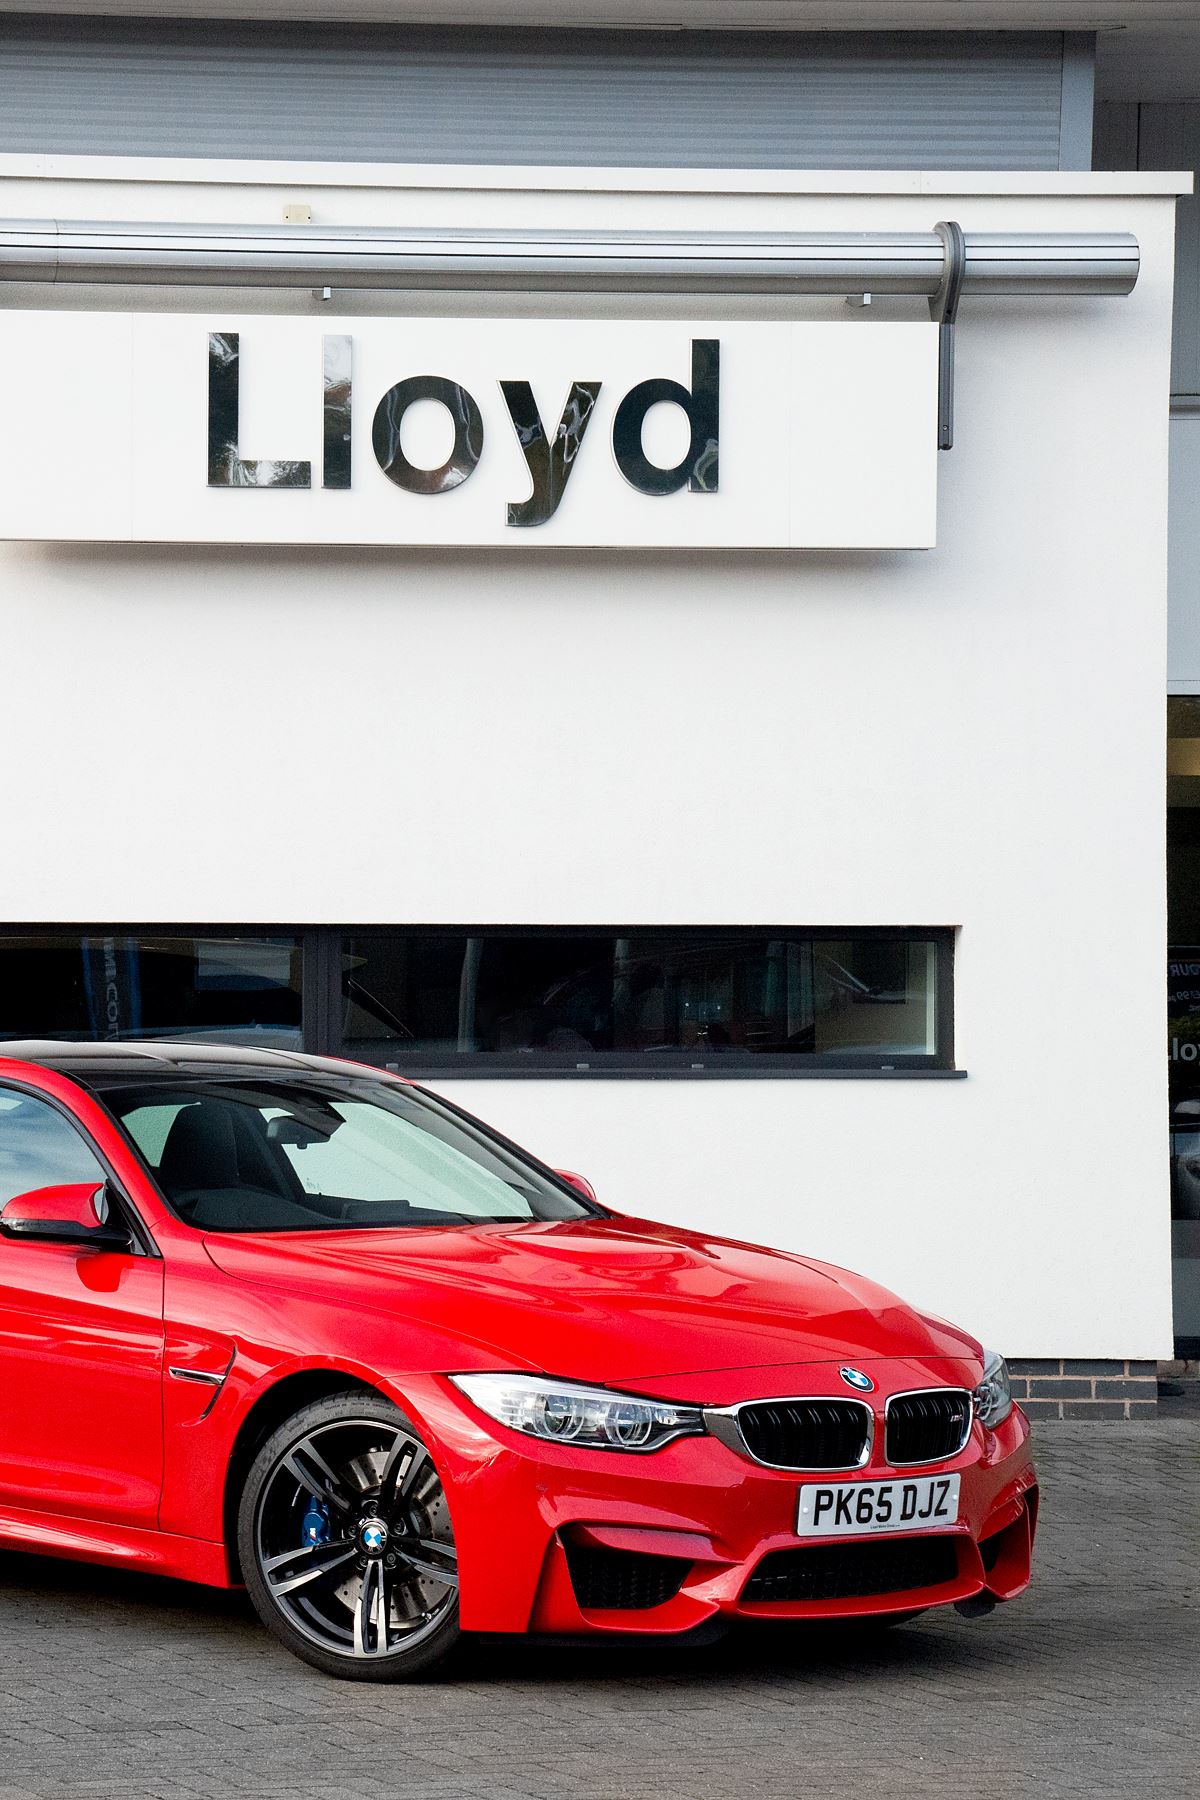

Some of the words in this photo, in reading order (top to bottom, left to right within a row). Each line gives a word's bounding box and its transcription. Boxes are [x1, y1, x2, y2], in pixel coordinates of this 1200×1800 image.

[207, 332, 721, 528] Lloyd
[1168, 1037, 1200, 1062] lo
[812, 1486, 892, 1526] PK65
[899, 1480, 950, 1521] DJZ
